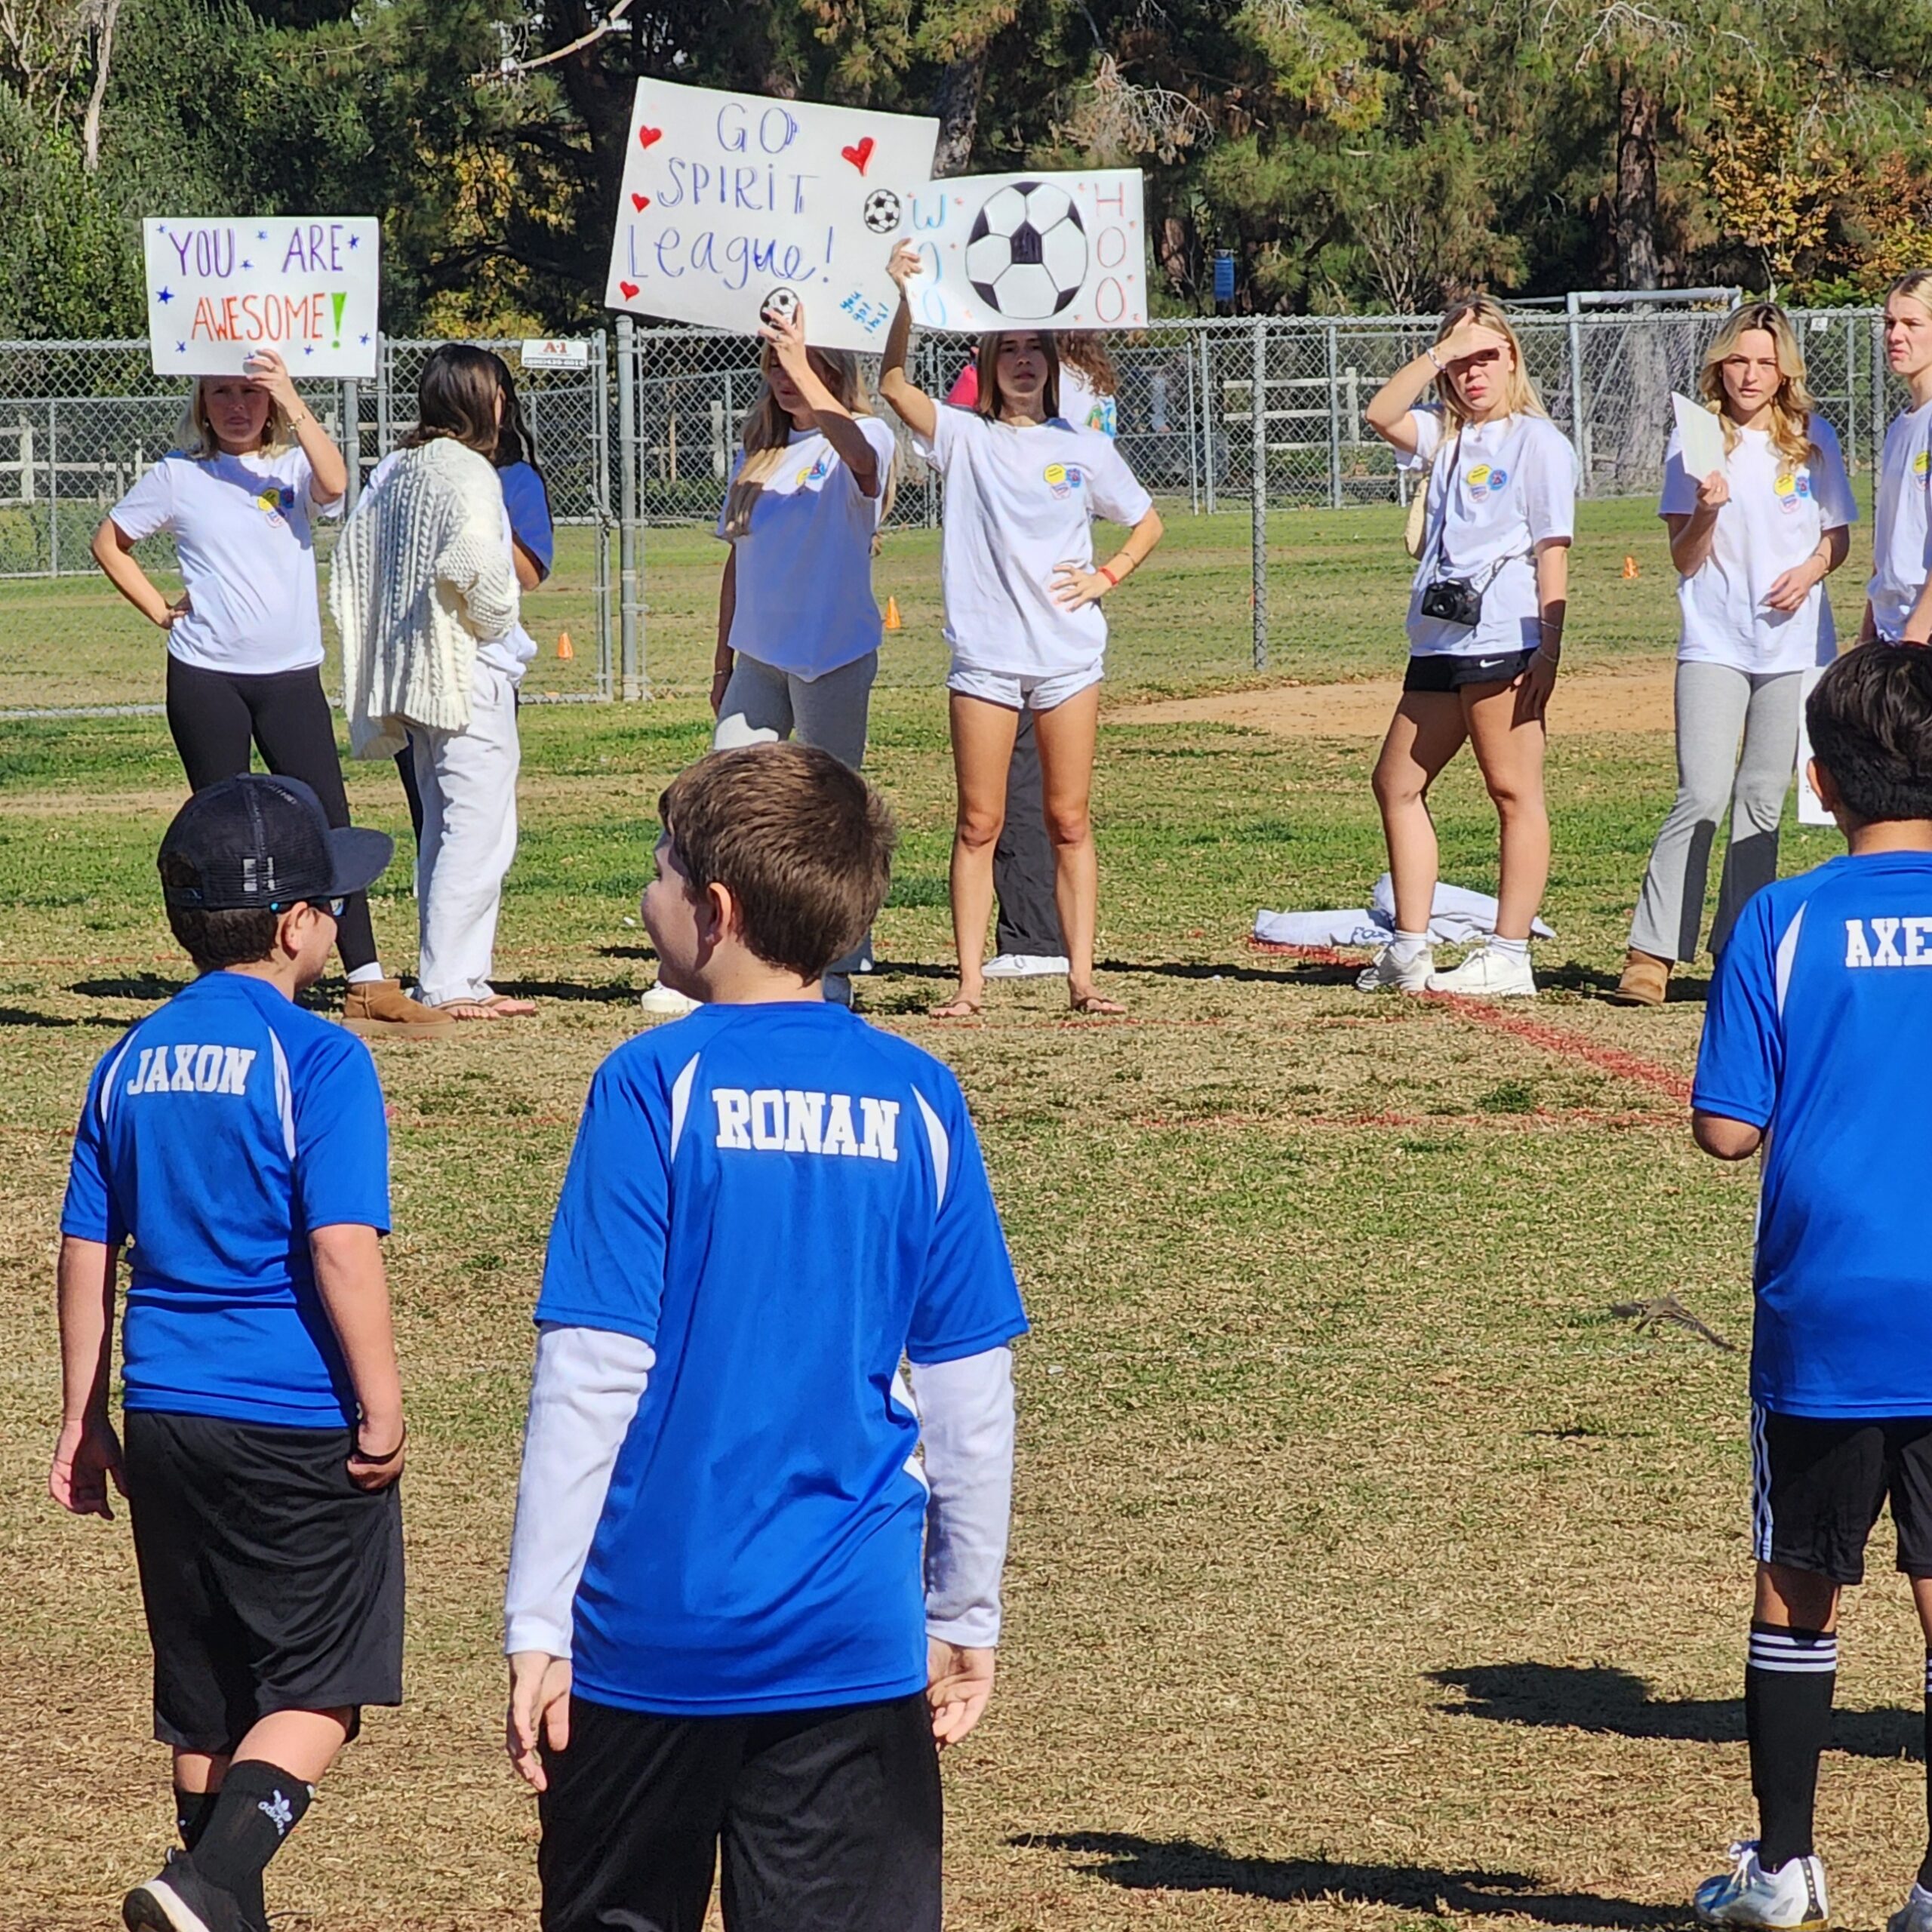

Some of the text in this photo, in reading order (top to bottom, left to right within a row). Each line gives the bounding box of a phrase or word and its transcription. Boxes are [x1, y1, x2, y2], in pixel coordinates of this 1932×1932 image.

[716, 103, 799, 154] GO
[168, 224, 344, 278] YOU ARE
[627, 224, 834, 290] League!
[191, 291, 347, 349] AWESOME!
[1844, 916, 1932, 968] AXE
[126, 1044, 257, 1096] JAXON
[712, 1088, 900, 1162] RONAN
